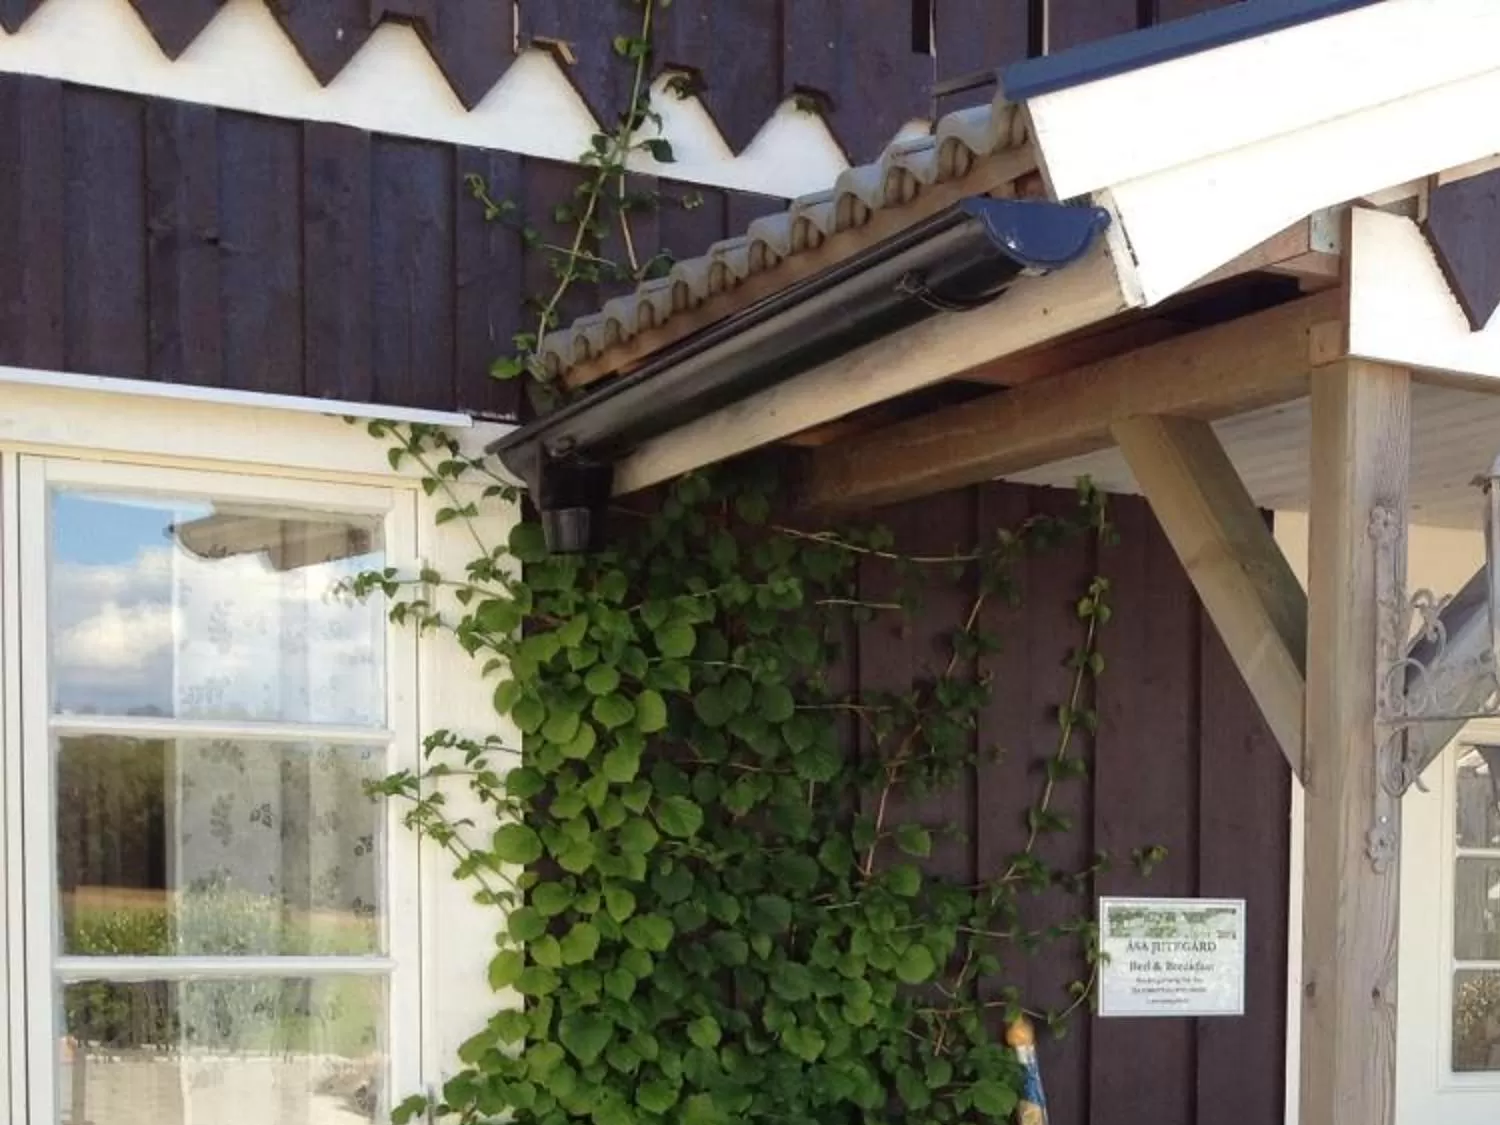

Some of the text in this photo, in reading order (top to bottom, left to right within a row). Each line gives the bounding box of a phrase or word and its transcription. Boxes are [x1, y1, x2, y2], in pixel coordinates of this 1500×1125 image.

[1129, 959, 1215, 972] Bed & Breakfast
